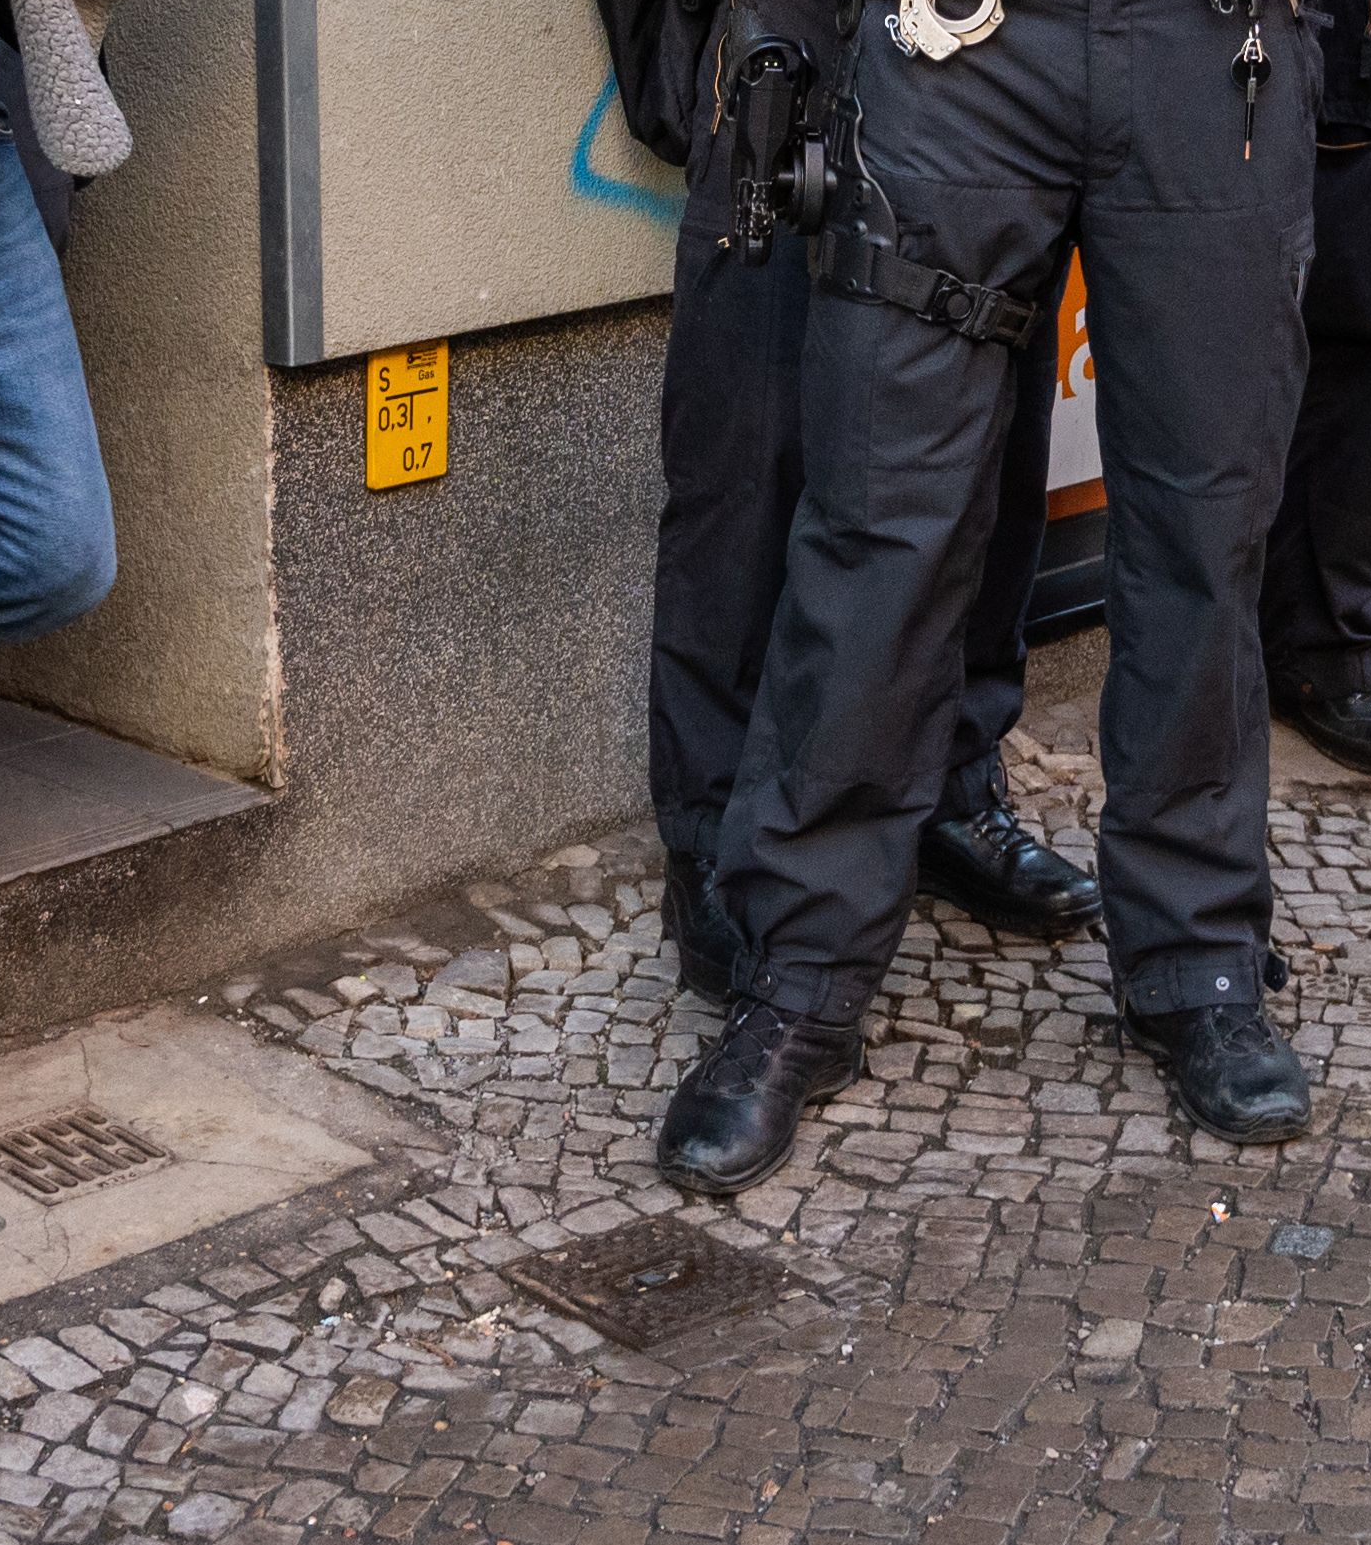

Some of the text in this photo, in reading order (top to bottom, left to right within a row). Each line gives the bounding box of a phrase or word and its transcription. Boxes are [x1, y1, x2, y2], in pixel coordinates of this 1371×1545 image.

[379, 366, 391, 393] S
[418, 369, 435, 381] Gas
[378, 402, 408, 433] 0,3
[402, 442, 433, 472] 0,7
